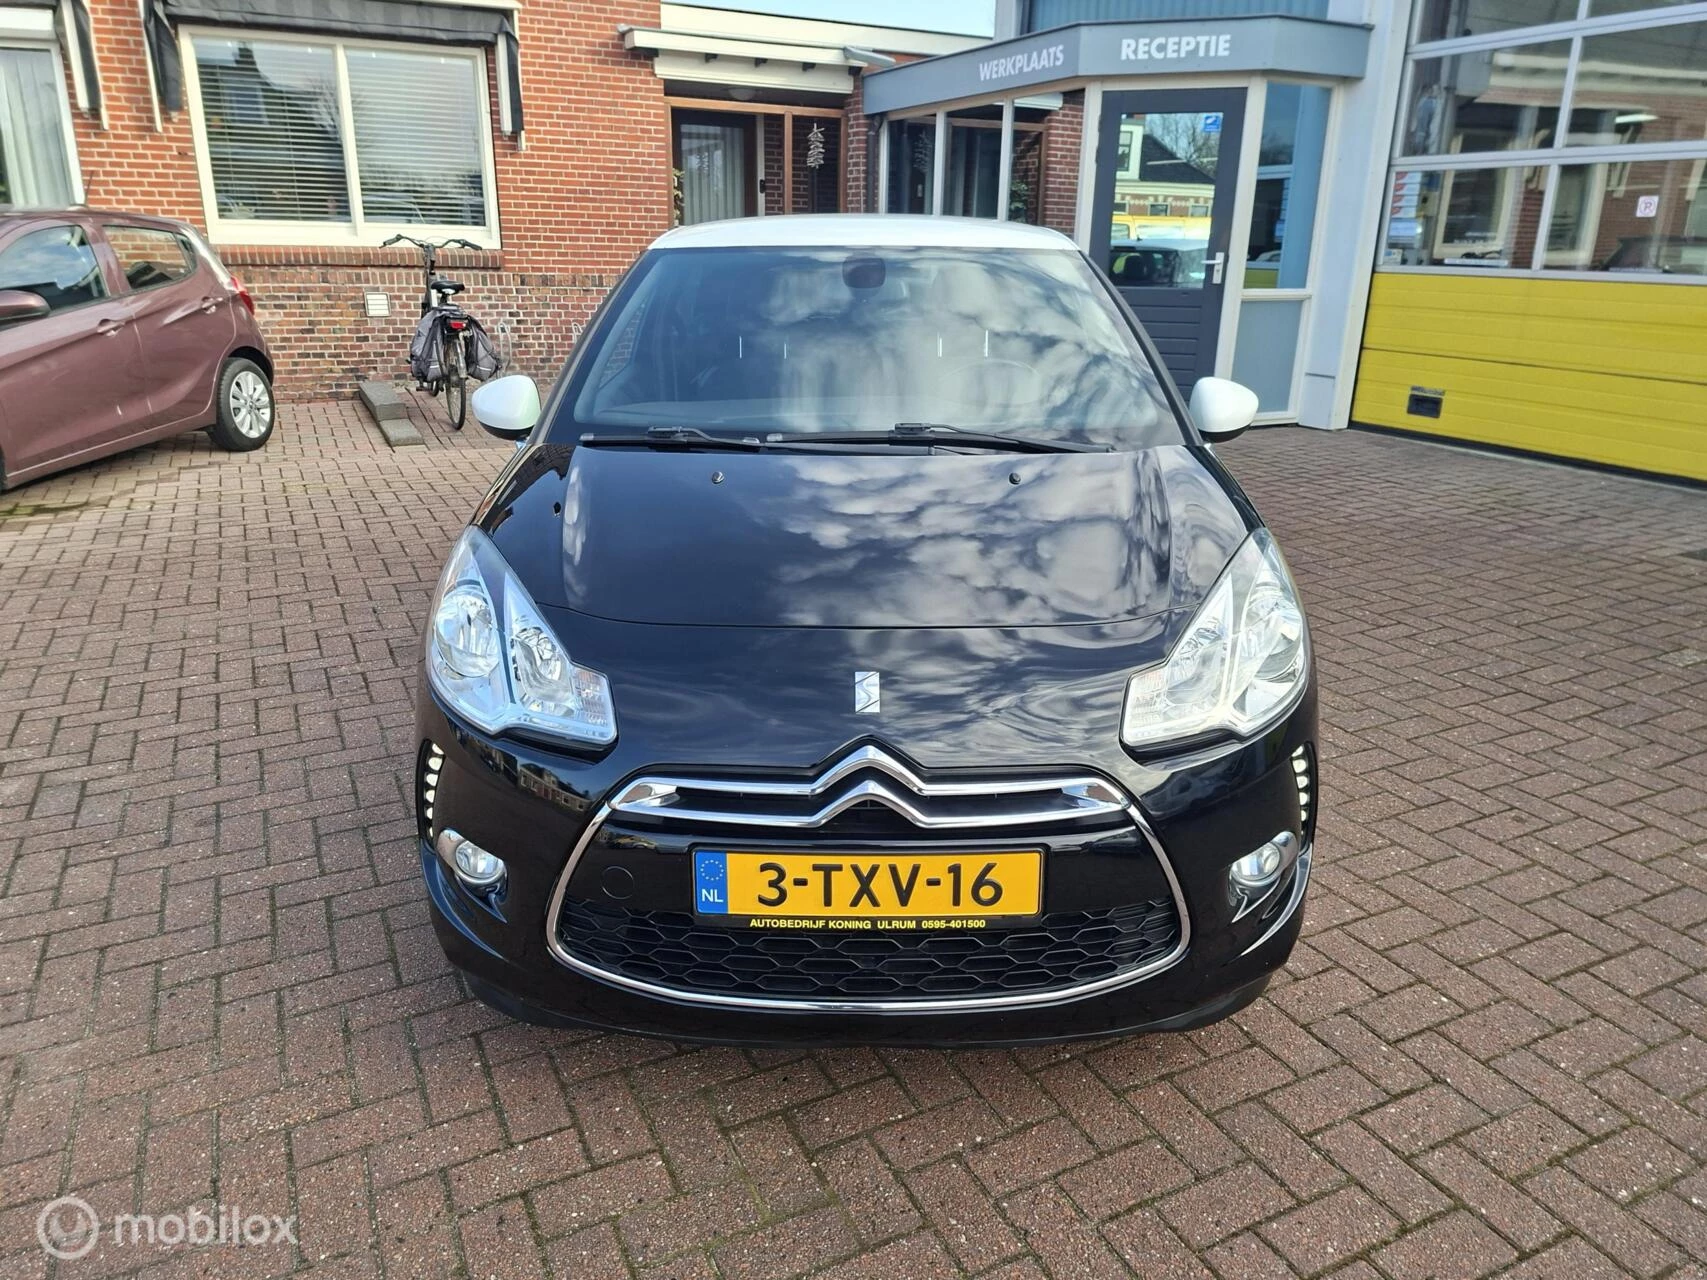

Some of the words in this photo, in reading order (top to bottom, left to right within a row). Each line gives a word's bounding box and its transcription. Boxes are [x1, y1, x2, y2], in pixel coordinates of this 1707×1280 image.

[1120, 34, 1232, 61] RECEPTIE
[979, 44, 1065, 81] WERKPLAATS
[701, 888, 724, 903] NL
[757, 862, 1004, 908] 3-TXV-16
[750, 918, 826, 929] AUTOBEDRIJF
[828, 919, 872, 930] KONING
[877, 919, 916, 930] ULRUM
[921, 919, 986, 930] 0595-401500
